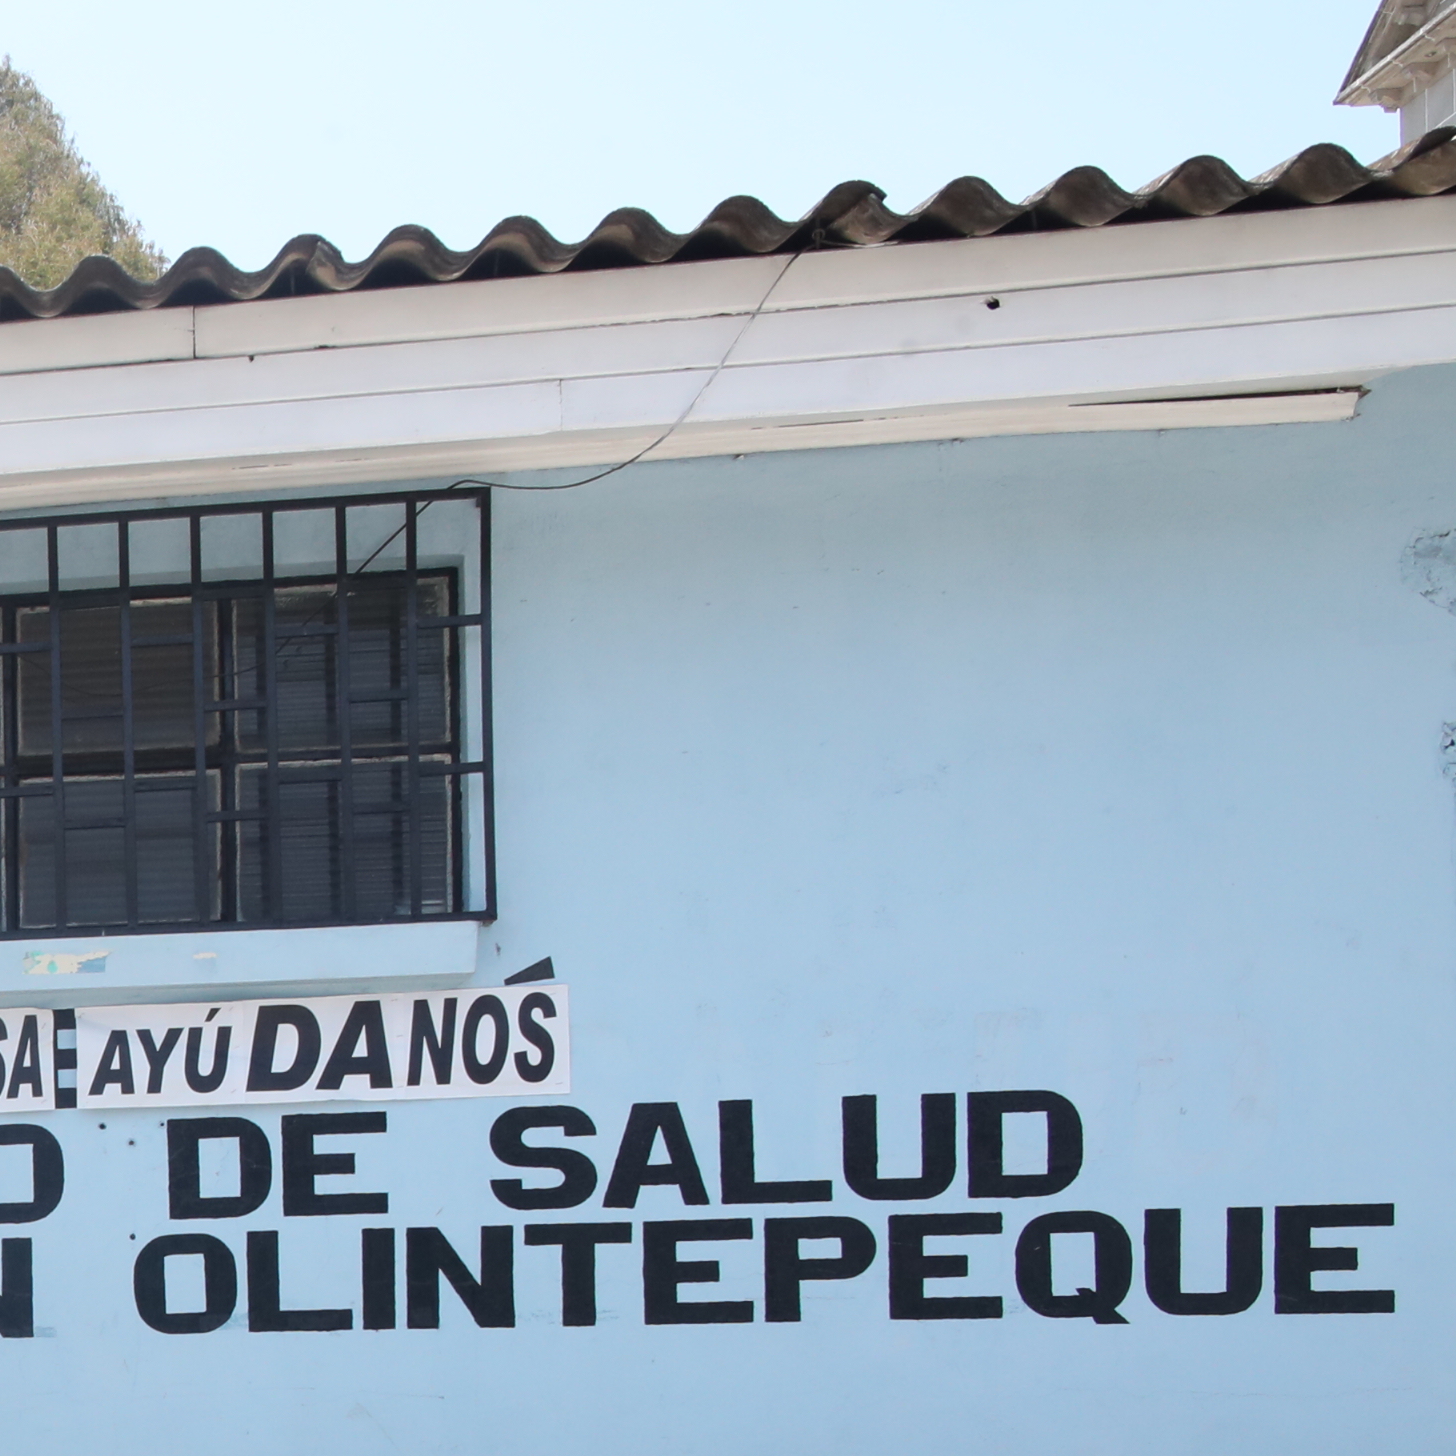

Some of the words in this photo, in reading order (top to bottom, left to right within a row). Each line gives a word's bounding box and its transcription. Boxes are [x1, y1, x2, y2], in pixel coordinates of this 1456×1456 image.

[167, 1111, 389, 1221] DE
[489, 1089, 1085, 1211] SALUD
[133, 1203, 1395, 1335] OLINTEPEQUE
